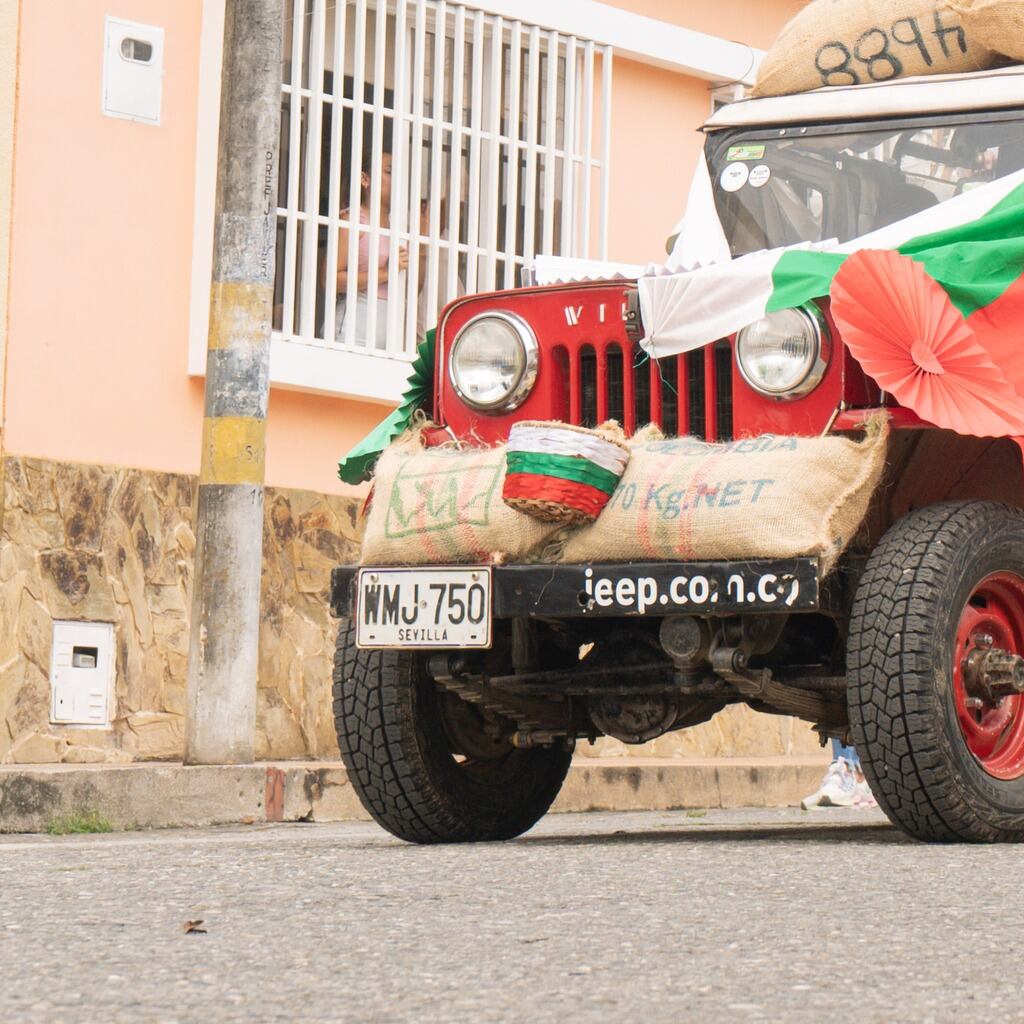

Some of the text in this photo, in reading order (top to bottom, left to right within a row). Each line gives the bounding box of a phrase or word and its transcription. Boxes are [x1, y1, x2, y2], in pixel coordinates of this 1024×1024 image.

[364, 583, 485, 625] WMJ 750
[398, 628, 448, 641] SEVILLA
